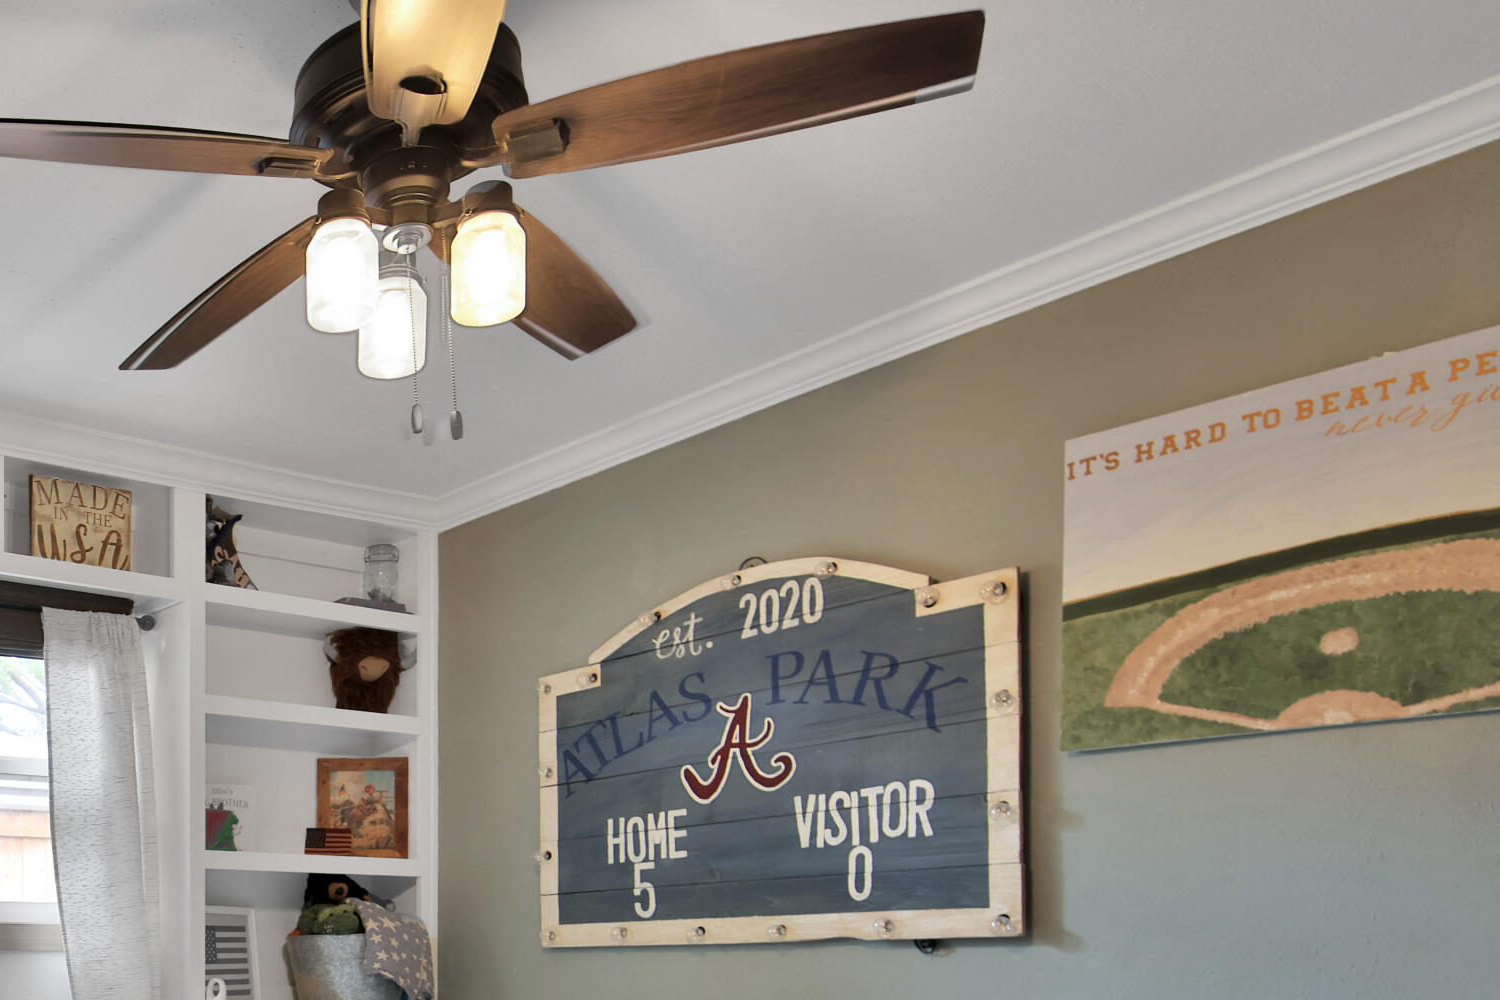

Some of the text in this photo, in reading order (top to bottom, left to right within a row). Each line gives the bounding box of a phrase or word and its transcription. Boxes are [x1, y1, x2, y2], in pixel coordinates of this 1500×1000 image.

[1067, 451, 1121, 481] IT'S
[1134, 421, 1227, 464] HARD
[1242, 408, 1281, 434] TO
[1295, 377, 1397, 422] BEAT
[1405, 370, 1431, 396] A
[1324, 404, 1429, 437] never
[33, 479, 130, 520] MADE
[53, 506, 113, 528] IN THE
[652, 577, 824, 661] est. 2020
[556, 649, 969, 800] ATLAS PARK
[680, 692, 796, 804] A
[607, 779, 935, 865] HOME VISITOR
[633, 845, 873, 919] 5 0
